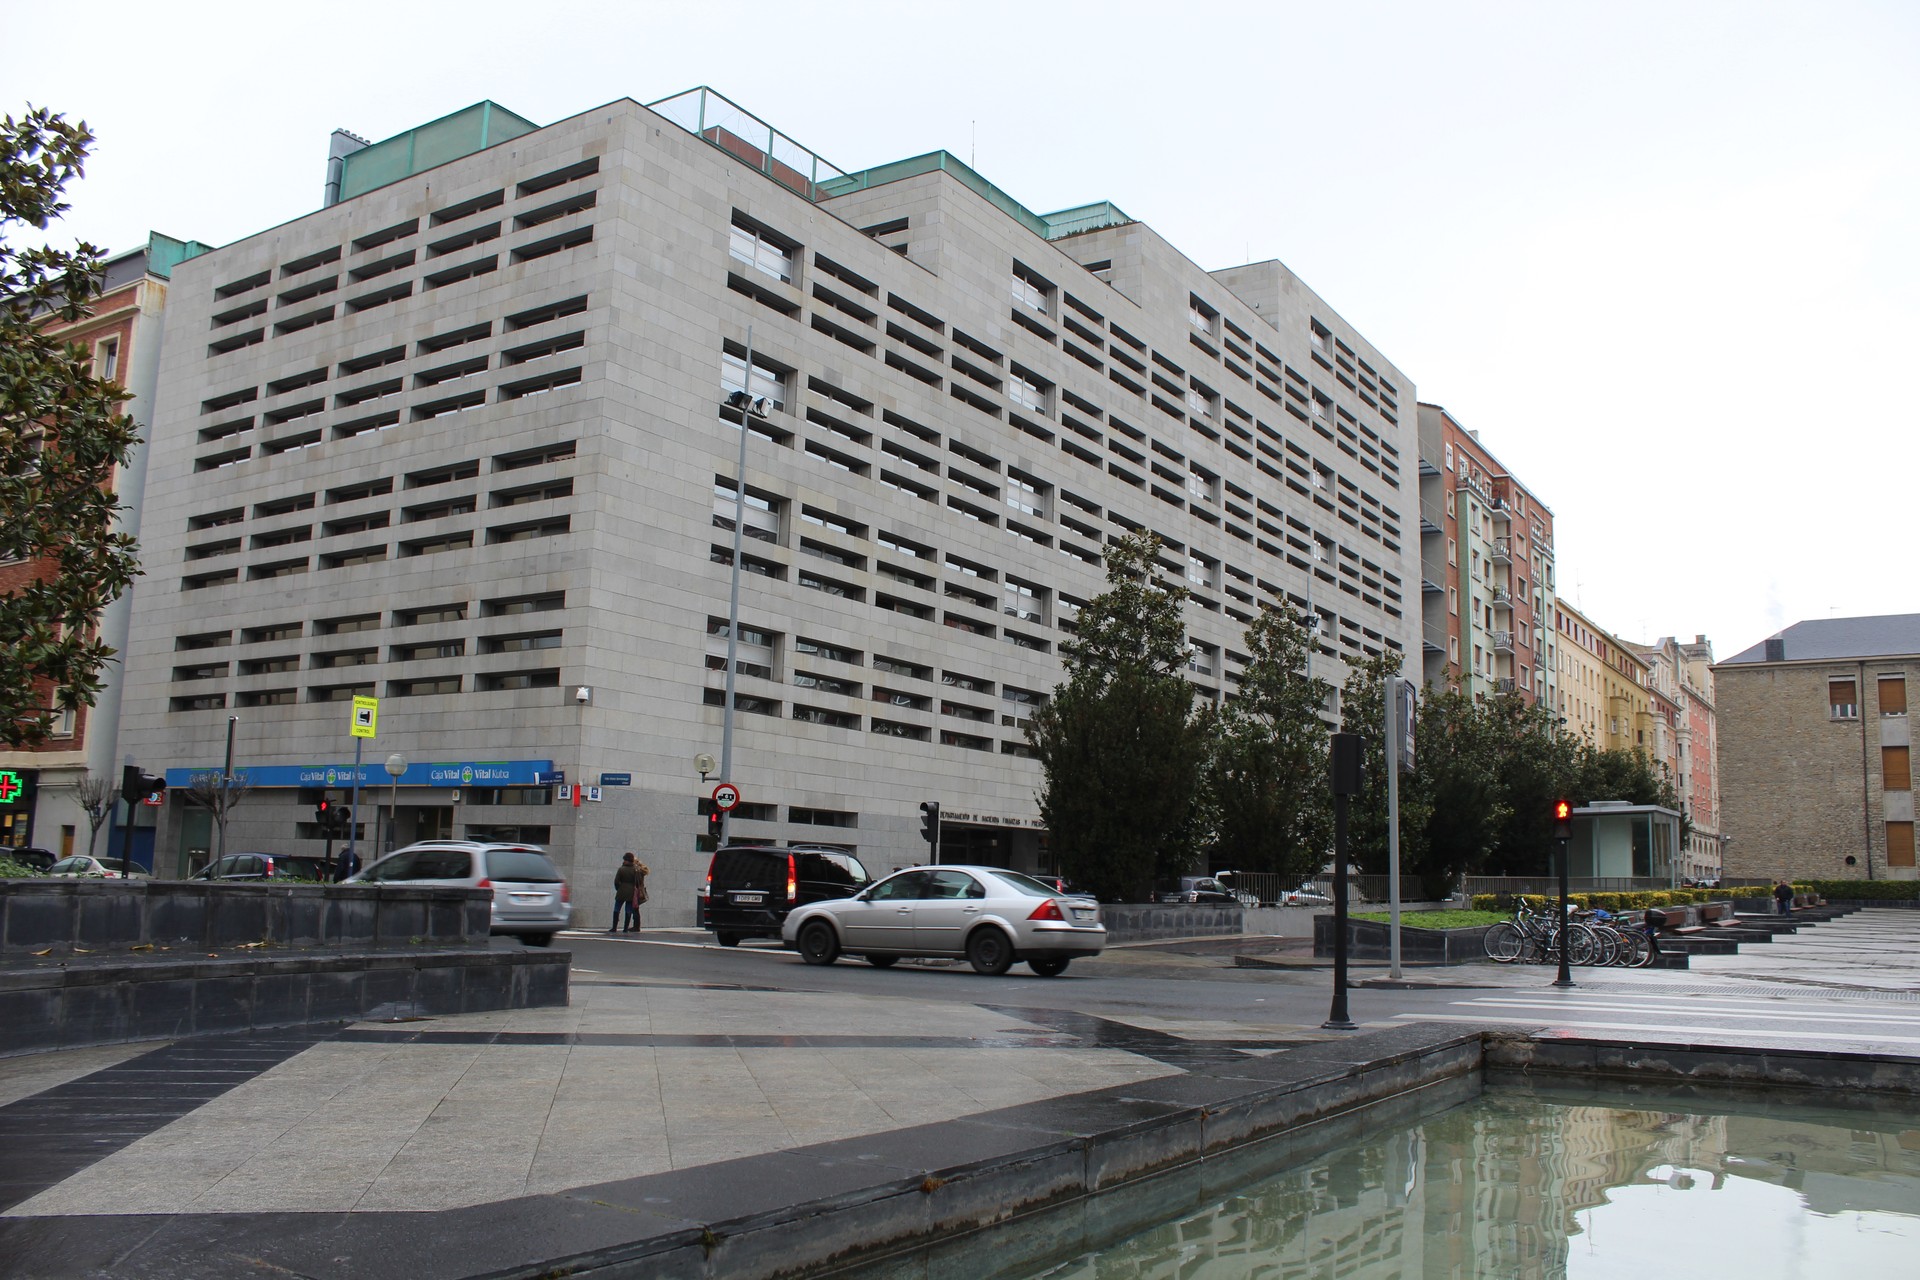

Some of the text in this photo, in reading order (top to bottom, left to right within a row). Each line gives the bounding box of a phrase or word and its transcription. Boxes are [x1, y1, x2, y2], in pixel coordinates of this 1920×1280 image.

[311, 771, 325, 781] Vital
[338, 771, 352, 781] Vital
[431, 769, 460, 781] Caja Vital
[474, 769, 509, 779] Vital Kutxa
